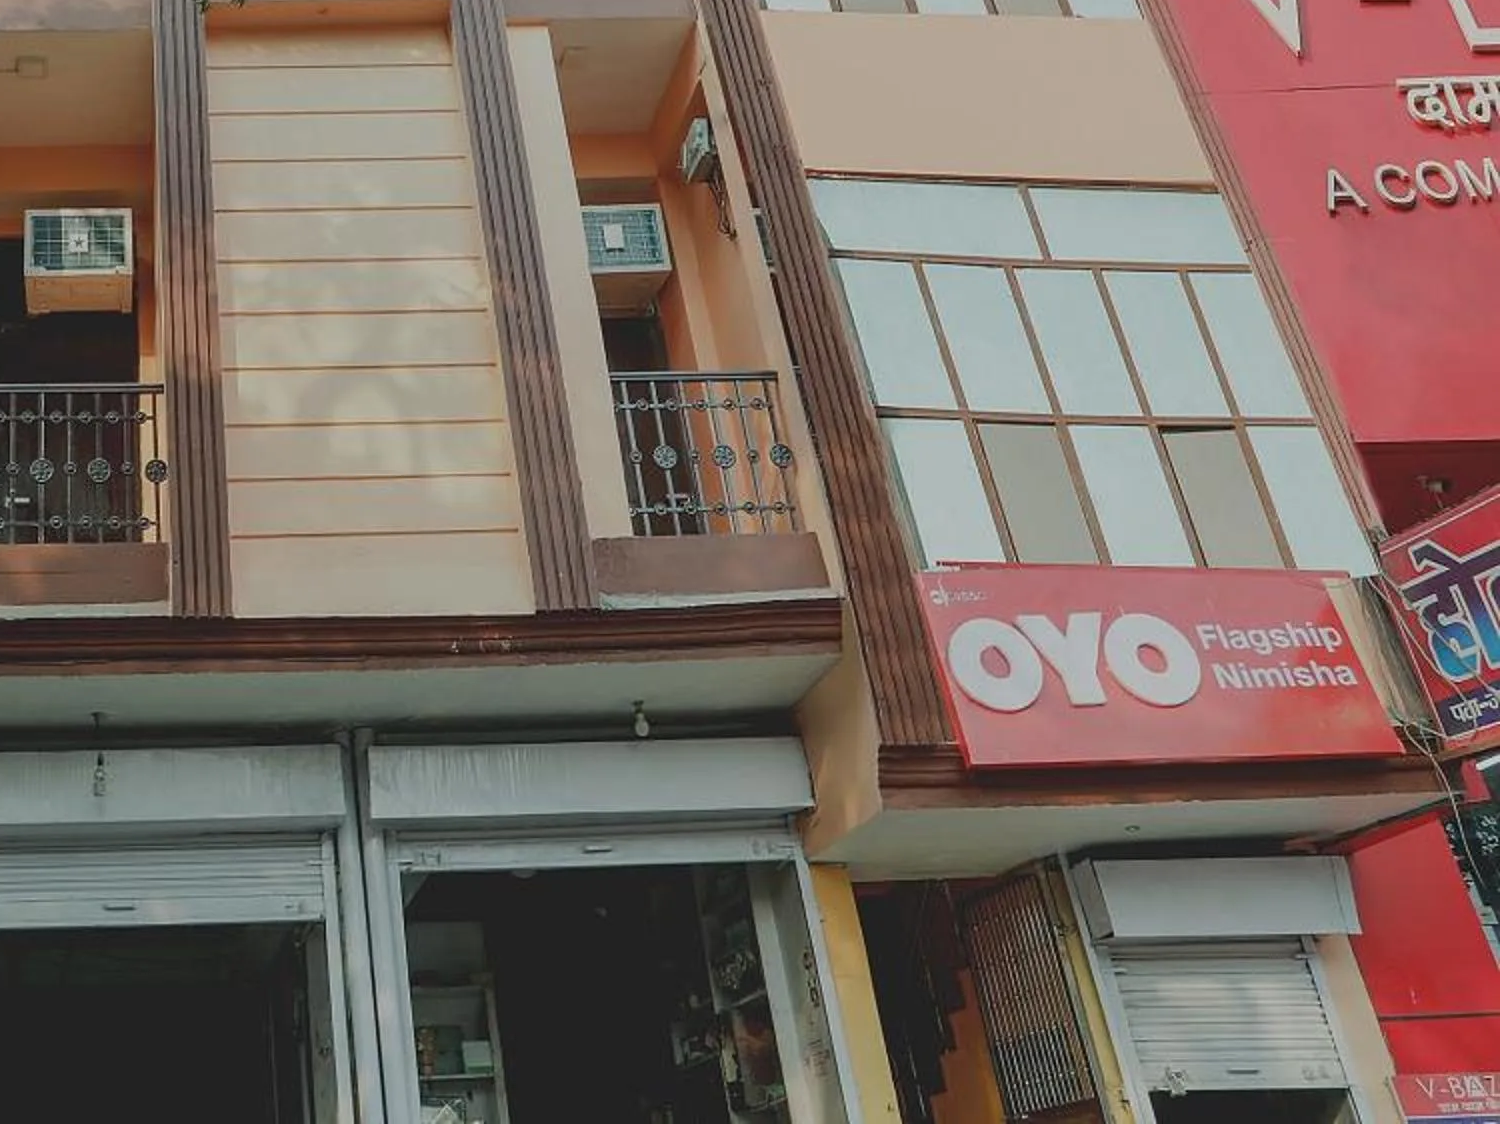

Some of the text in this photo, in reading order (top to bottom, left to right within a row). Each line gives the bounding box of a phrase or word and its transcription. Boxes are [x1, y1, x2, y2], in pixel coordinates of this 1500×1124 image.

[1327, 168, 1370, 217] A
[947, 612, 1343, 713] OYO Flagship
[1211, 659, 1358, 690] Nimisha
